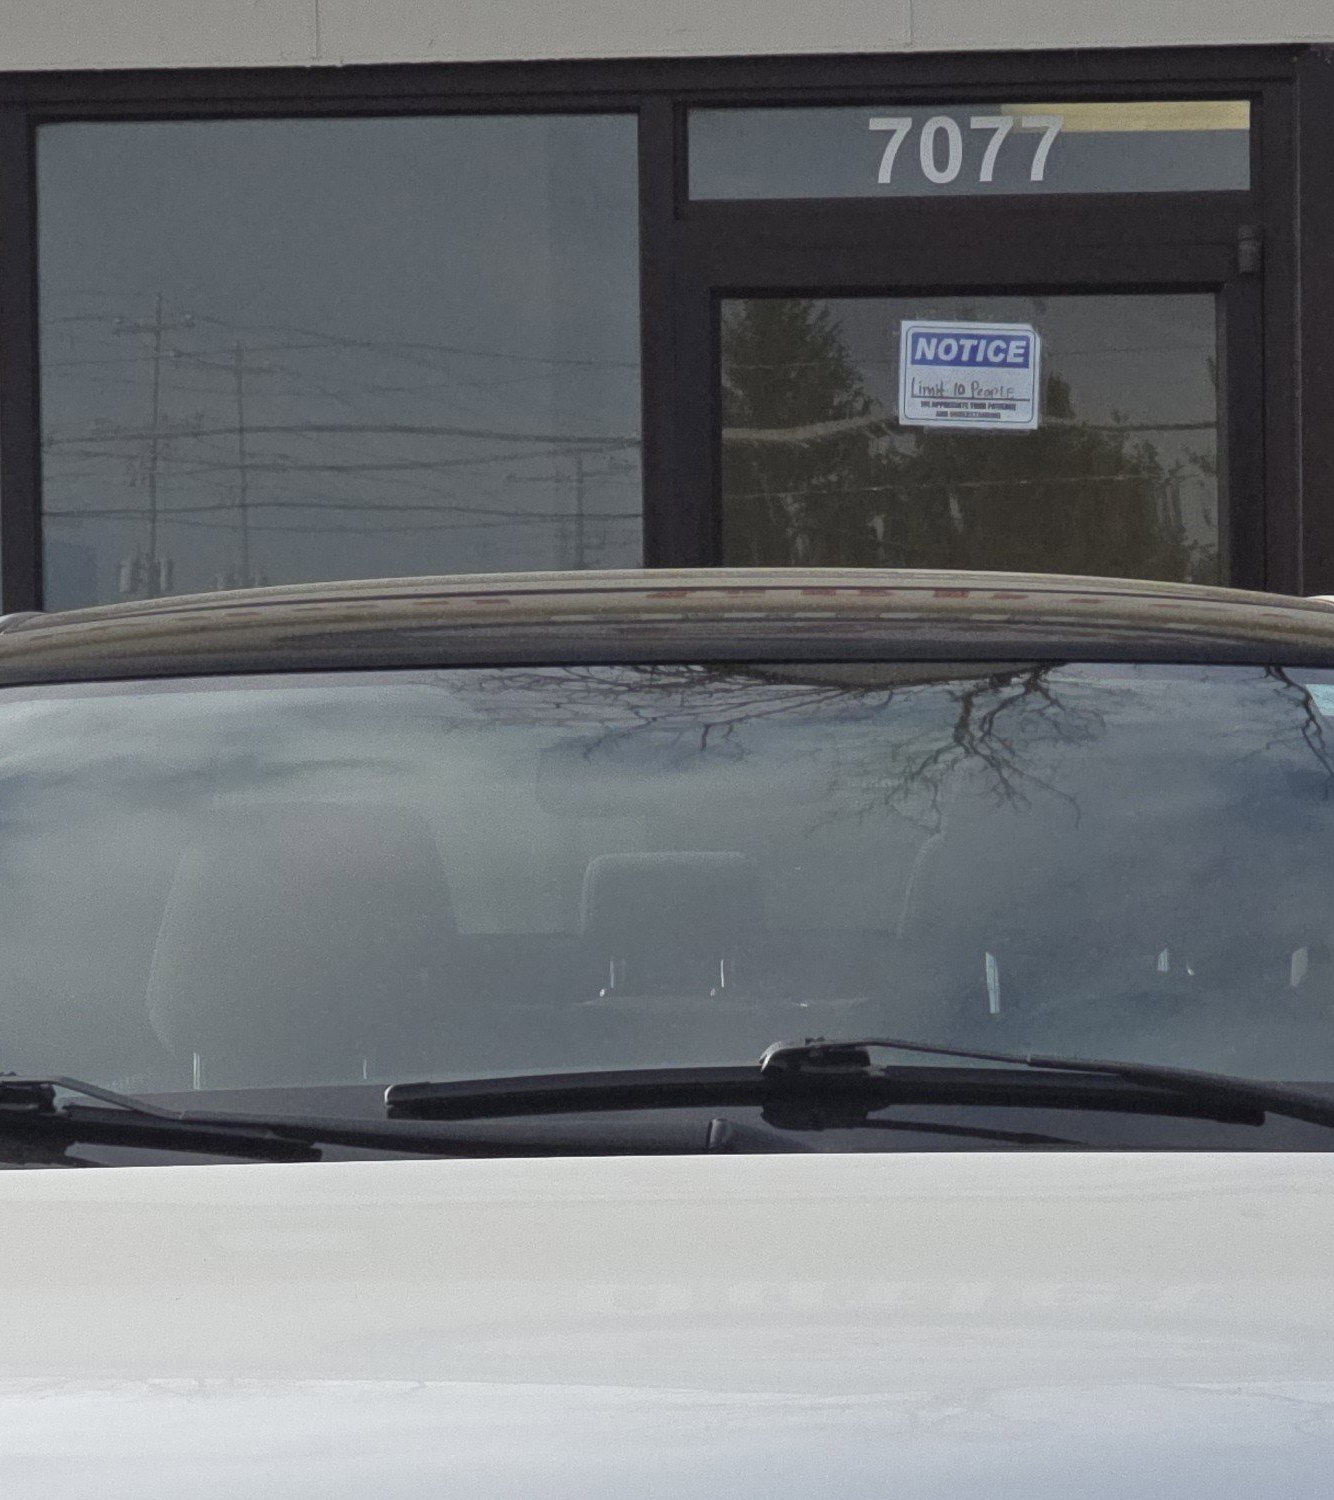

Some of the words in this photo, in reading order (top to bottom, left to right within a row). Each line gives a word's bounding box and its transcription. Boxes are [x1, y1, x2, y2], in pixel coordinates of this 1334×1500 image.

[868, 115, 1064, 184] 7077
[914, 337, 1028, 364] NOTICE
[910, 376, 945, 397] Limit
[953, 381, 966, 396] 10
